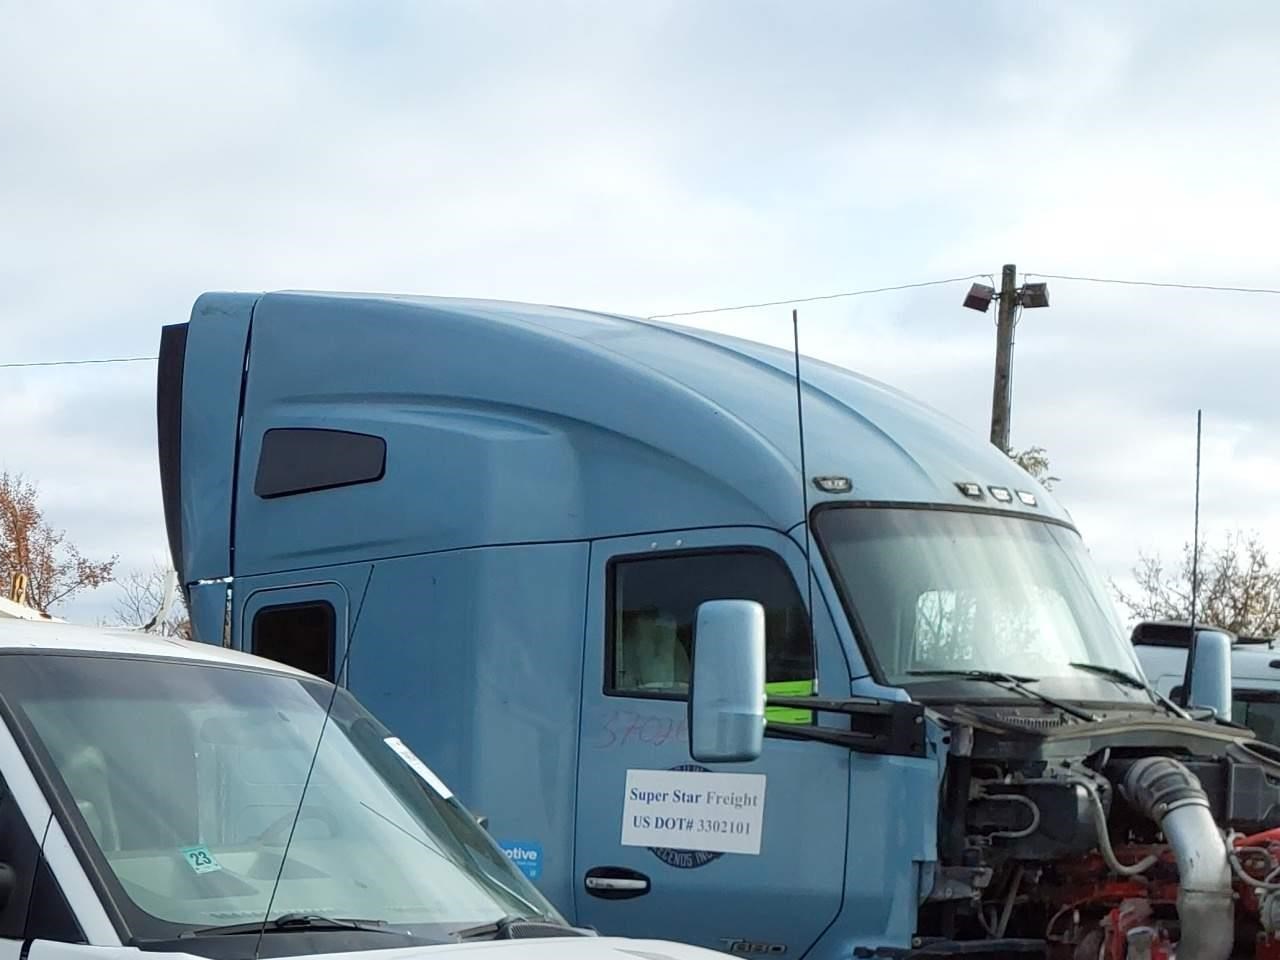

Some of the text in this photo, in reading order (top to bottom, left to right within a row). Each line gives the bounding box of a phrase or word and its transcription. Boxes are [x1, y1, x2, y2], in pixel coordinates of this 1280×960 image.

[630, 788, 757, 808] Super Star Freight
[633, 815, 750, 834] US DOT# 3302101
[189, 851, 212, 866] 23
[504, 847, 537, 860] otive
